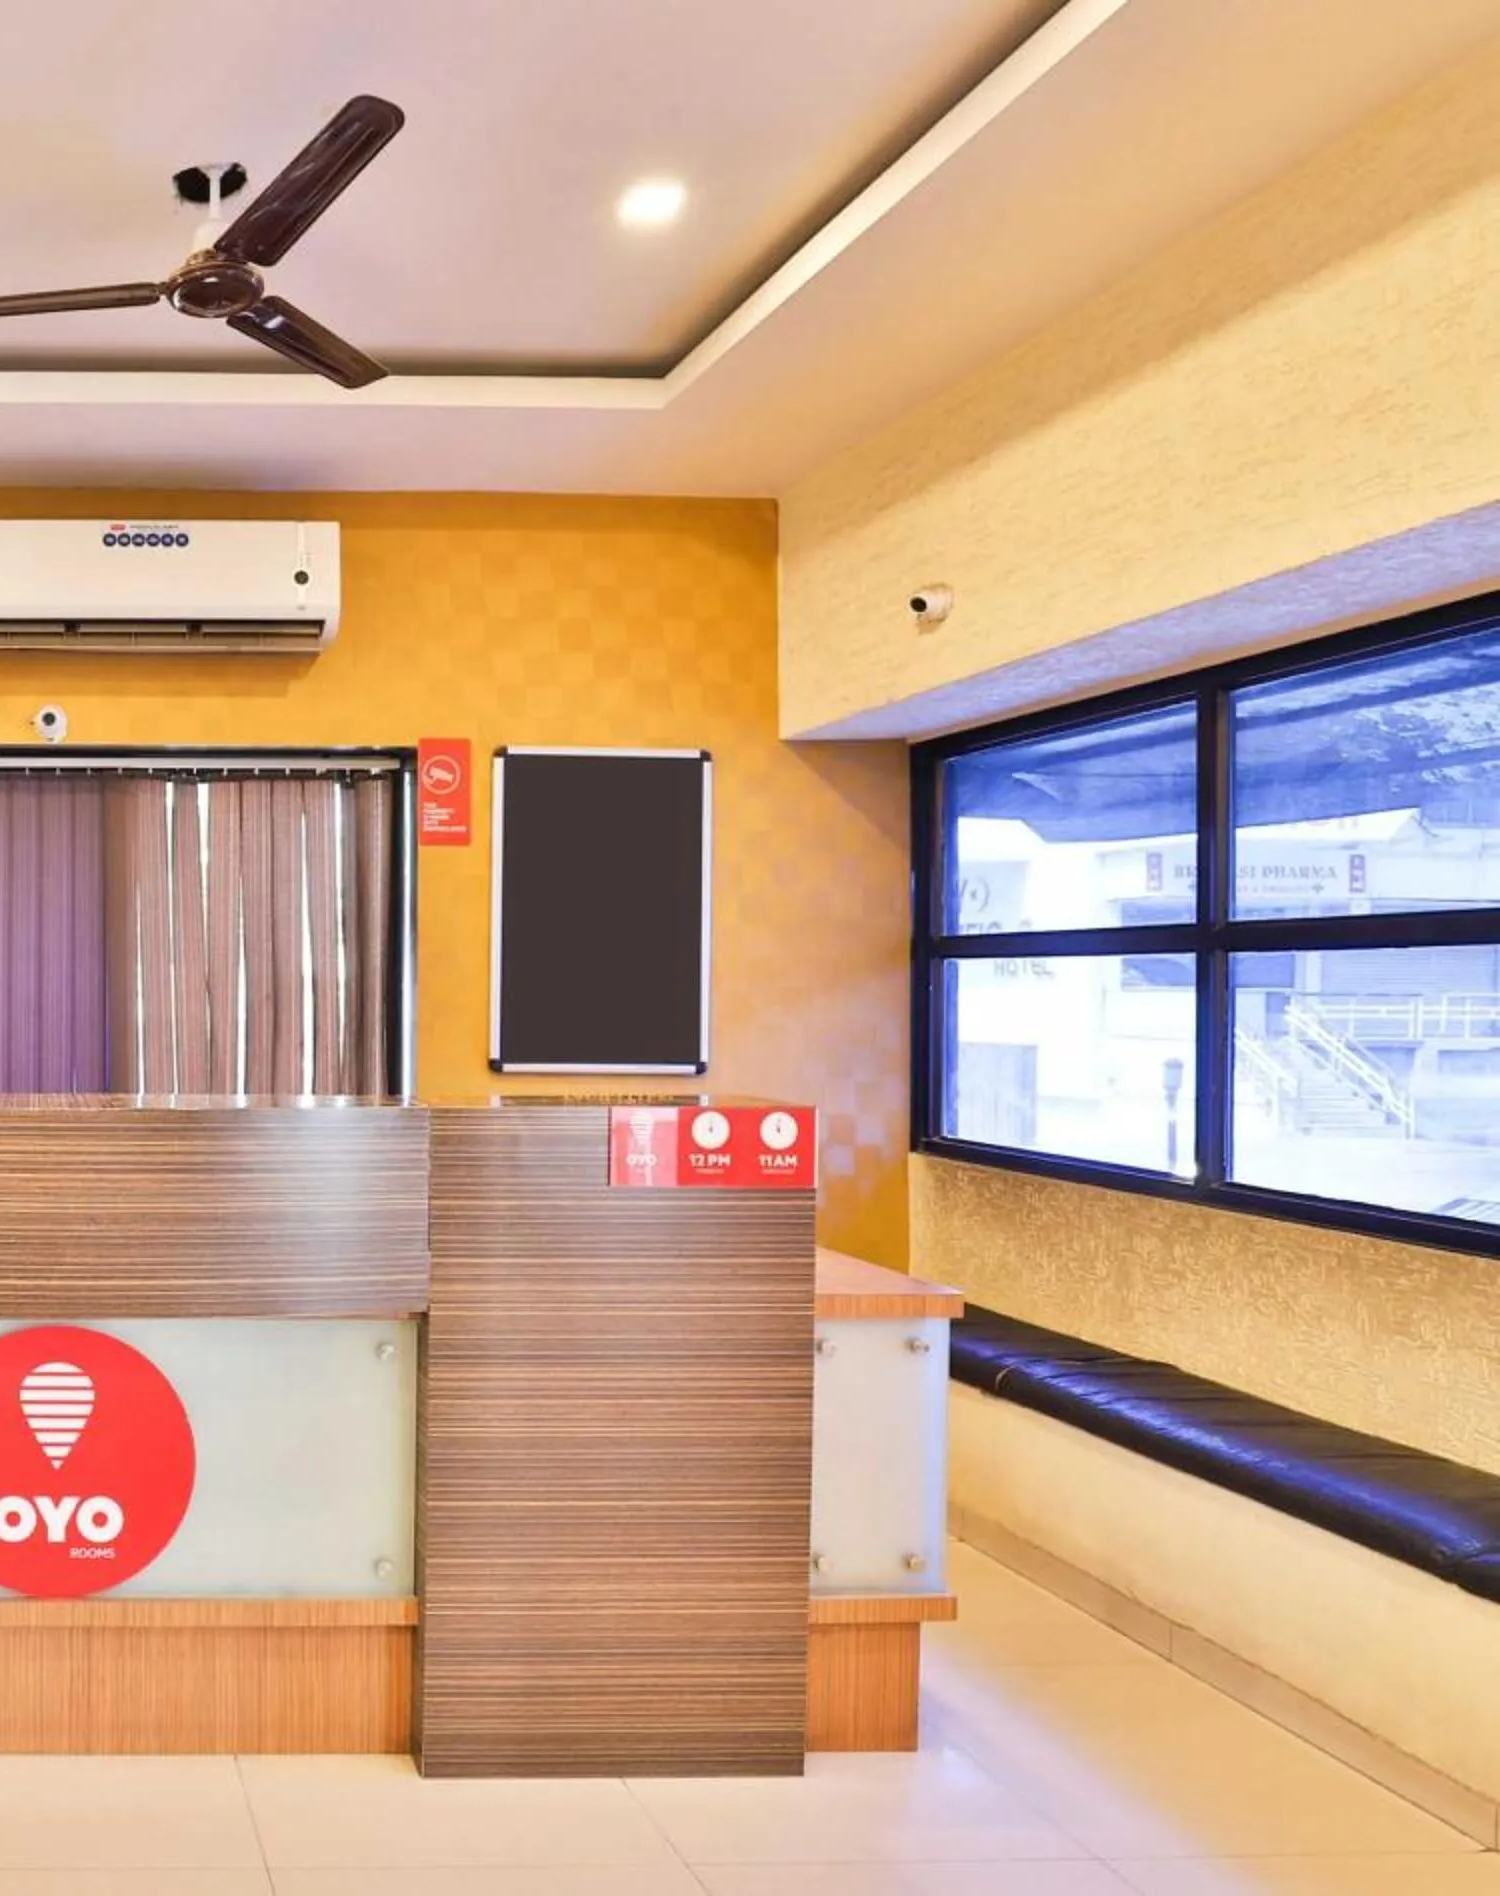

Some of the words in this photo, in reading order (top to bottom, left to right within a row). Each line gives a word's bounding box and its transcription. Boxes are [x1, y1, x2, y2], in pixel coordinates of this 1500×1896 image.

[626, 1154, 657, 1167] OYO
[689, 1153, 705, 1167] 12
[707, 1153, 731, 1167] PM
[759, 1154, 773, 1168] 11
[774, 1154, 798, 1168] AM
[69, 1547, 115, 1559] ROOMS
